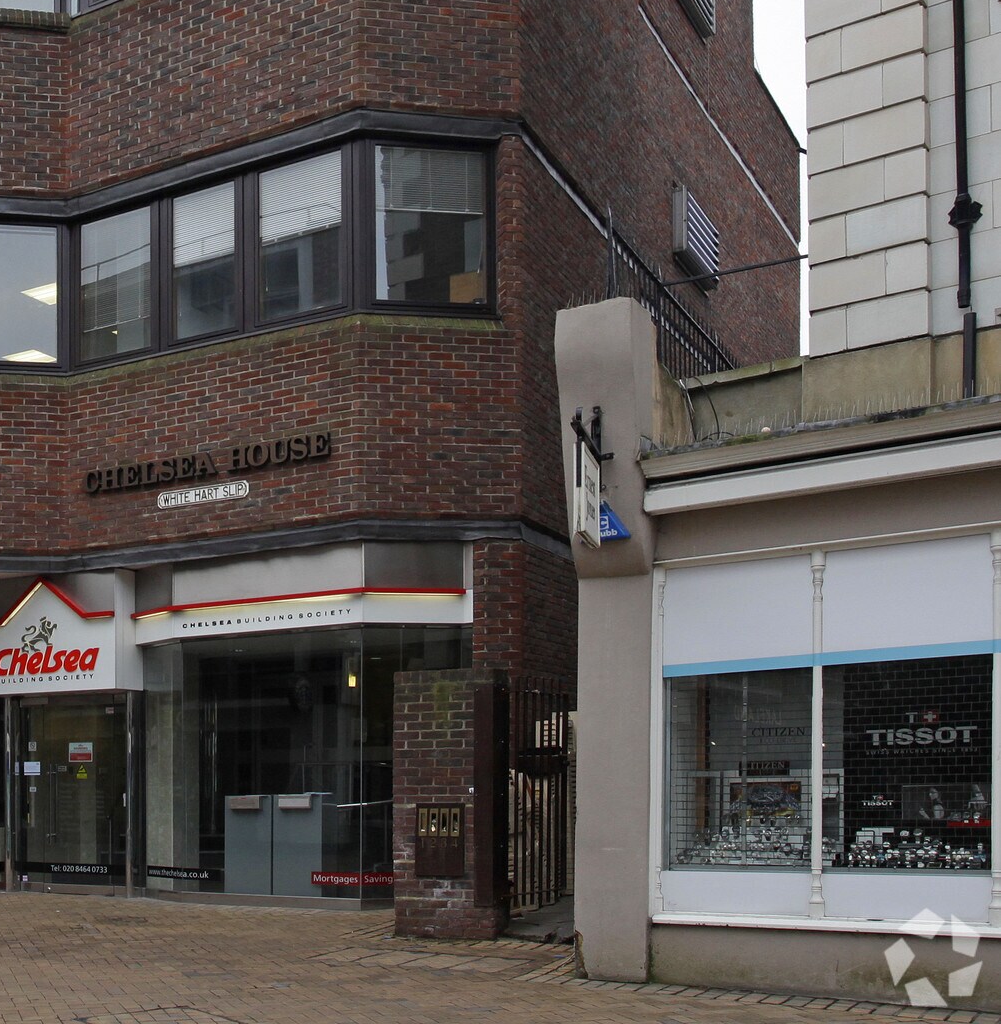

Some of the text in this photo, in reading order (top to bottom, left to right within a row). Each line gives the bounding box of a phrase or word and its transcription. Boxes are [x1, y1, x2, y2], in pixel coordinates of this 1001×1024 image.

[84, 431, 332, 493] CHELSEA HOUSE
[162, 483, 245, 506] WHITE HART SLIP
[600, 528, 617, 537] ubb
[182, 608, 352, 629] CHELSEA BUILDING SOCIETY
[48, 674, 94, 682] SOCIETY
[752, 727, 805, 736] CITIZEN
[866, 725, 978, 746] TISSOT
[749, 761, 785, 769] ITIZEN
[50, 864, 62, 872] Tel:
[92, 866, 108, 874] 0733
[149, 868, 209, 879] www.thechelsea.co.uk
[313, 874, 393, 885] Mortgages Saving
